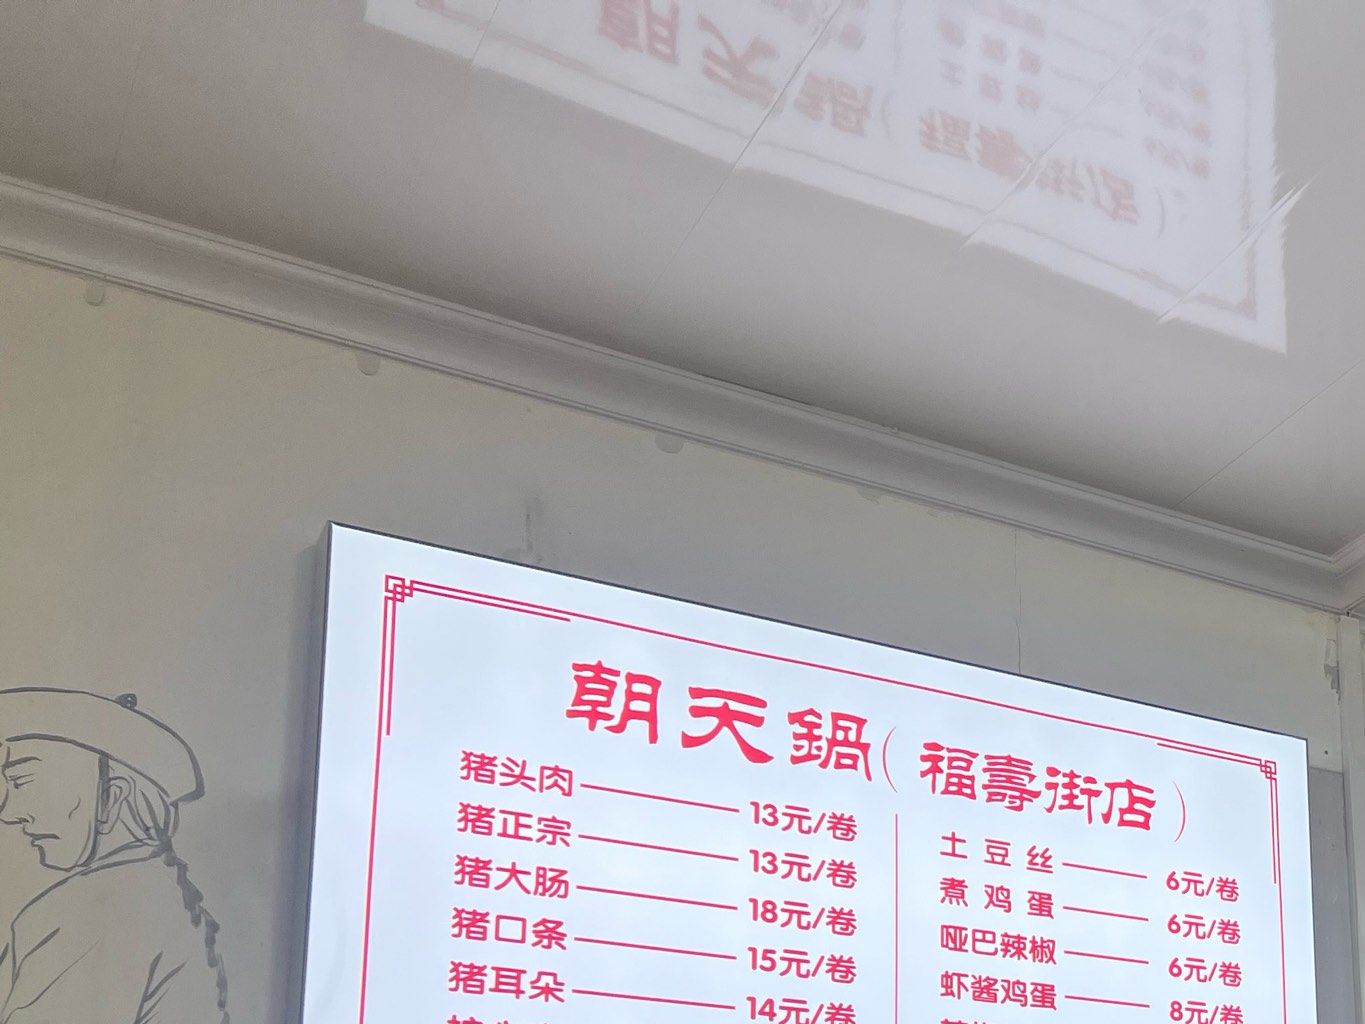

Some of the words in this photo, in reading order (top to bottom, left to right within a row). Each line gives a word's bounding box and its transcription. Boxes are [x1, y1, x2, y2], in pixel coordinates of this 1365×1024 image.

[564, 660, 874, 782] 朝天鍋
[460, 751, 574, 797] 猪头肉
[751, 800, 857, 843] 13元/卷
[457, 802, 572, 847] 猪正宗
[750, 848, 856, 889] 13元/卷
[454, 855, 570, 899] 猪大肠
[748, 897, 856, 937] 18元/卷
[1165, 870, 1238, 902] 6元/卷
[451, 907, 567, 950] 猪口条
[747, 946, 856, 985] 15元/卷
[940, 923, 1057, 964] 哑巴辣椒
[1168, 956, 1241, 988] 6元/卷
[1167, 913, 1239, 945] 6元/卷
[448, 961, 564, 1003] 猪耳朵
[940, 971, 1056, 1010] 虾酱鸡蛋
